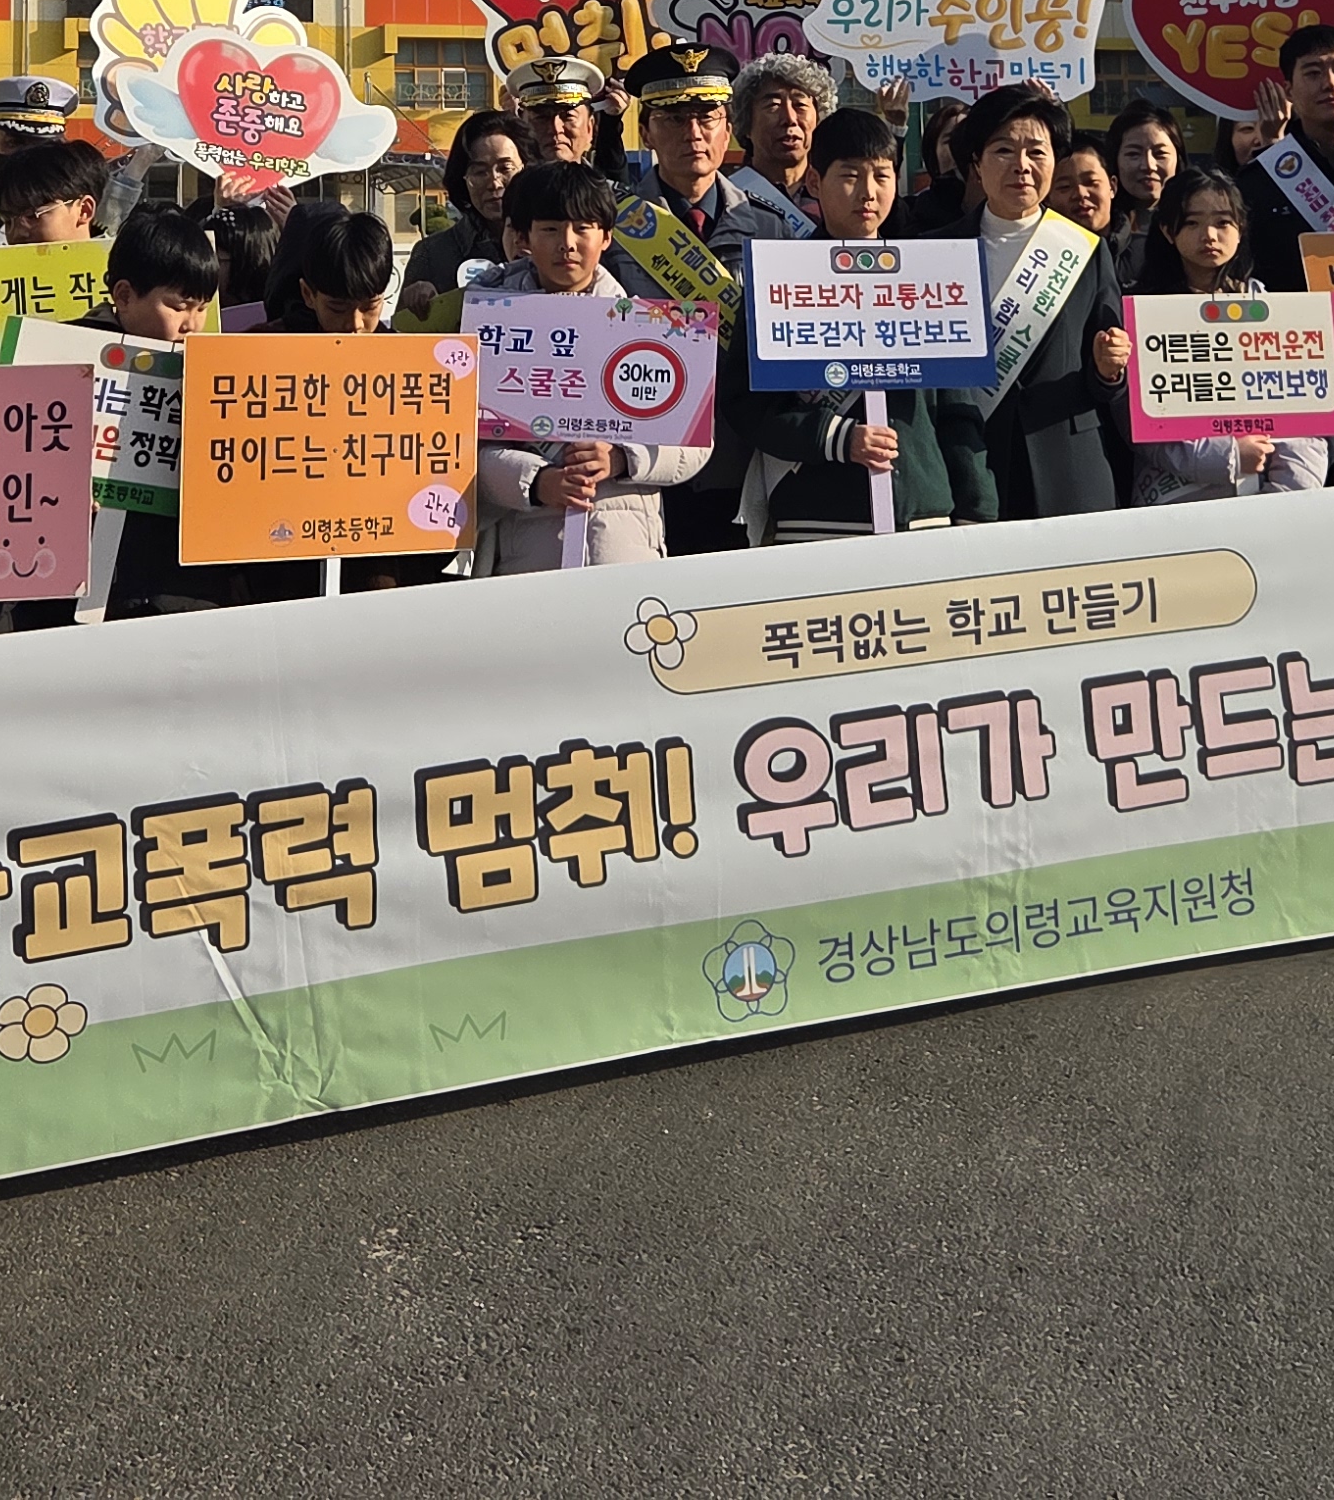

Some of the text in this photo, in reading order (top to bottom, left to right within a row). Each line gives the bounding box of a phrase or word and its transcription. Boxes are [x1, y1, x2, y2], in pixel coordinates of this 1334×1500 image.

[698, 11, 824, 66] NO
[216, 72, 307, 111] 사랑하고
[867, 54, 1085, 99] 행복한 학교 만들기
[212, 98, 303, 145] 존중해요
[195, 142, 311, 178] 폭력없는 우리학교
[668, 229, 720, 285] 사람이
[1016, 248, 1049, 295] 우리
[651, 253, 696, 298] 속도를
[1032, 249, 1079, 318] 안전한
[769, 282, 968, 310] 바로보자 교통신호
[477, 325, 579, 357] 학교 앞
[772, 320, 972, 348] 바로걷자 횡단보도
[1145, 330, 1324, 362] 어른들은 안전운전
[444, 348, 470, 369] 사랑
[618, 363, 671, 383] 30km
[850, 363, 922, 378] 의령초등학교
[210, 370, 453, 420] 무심코한 언어폭력
[496, 368, 588, 399] 스쿨존
[631, 385, 657, 401] 미만
[1149, 369, 1328, 403] 우리들은 안전보행
[557, 416, 633, 433] 의령초등학교
[1212, 418, 1274, 433] 의령초등학교
[92, 425, 121, 462] 은
[209, 432, 462, 483] 멍이드는 친구마음!
[425, 492, 458, 528] 관심
[301, 517, 395, 545] 의령초등학교
[760, 578, 1159, 672] 폭력없는 학교 만들기
[415, 735, 699, 916] 멈춰!
[733, 690, 1057, 860] 우리가
[817, 866, 1258, 988] 경상남도의령교육지원청
